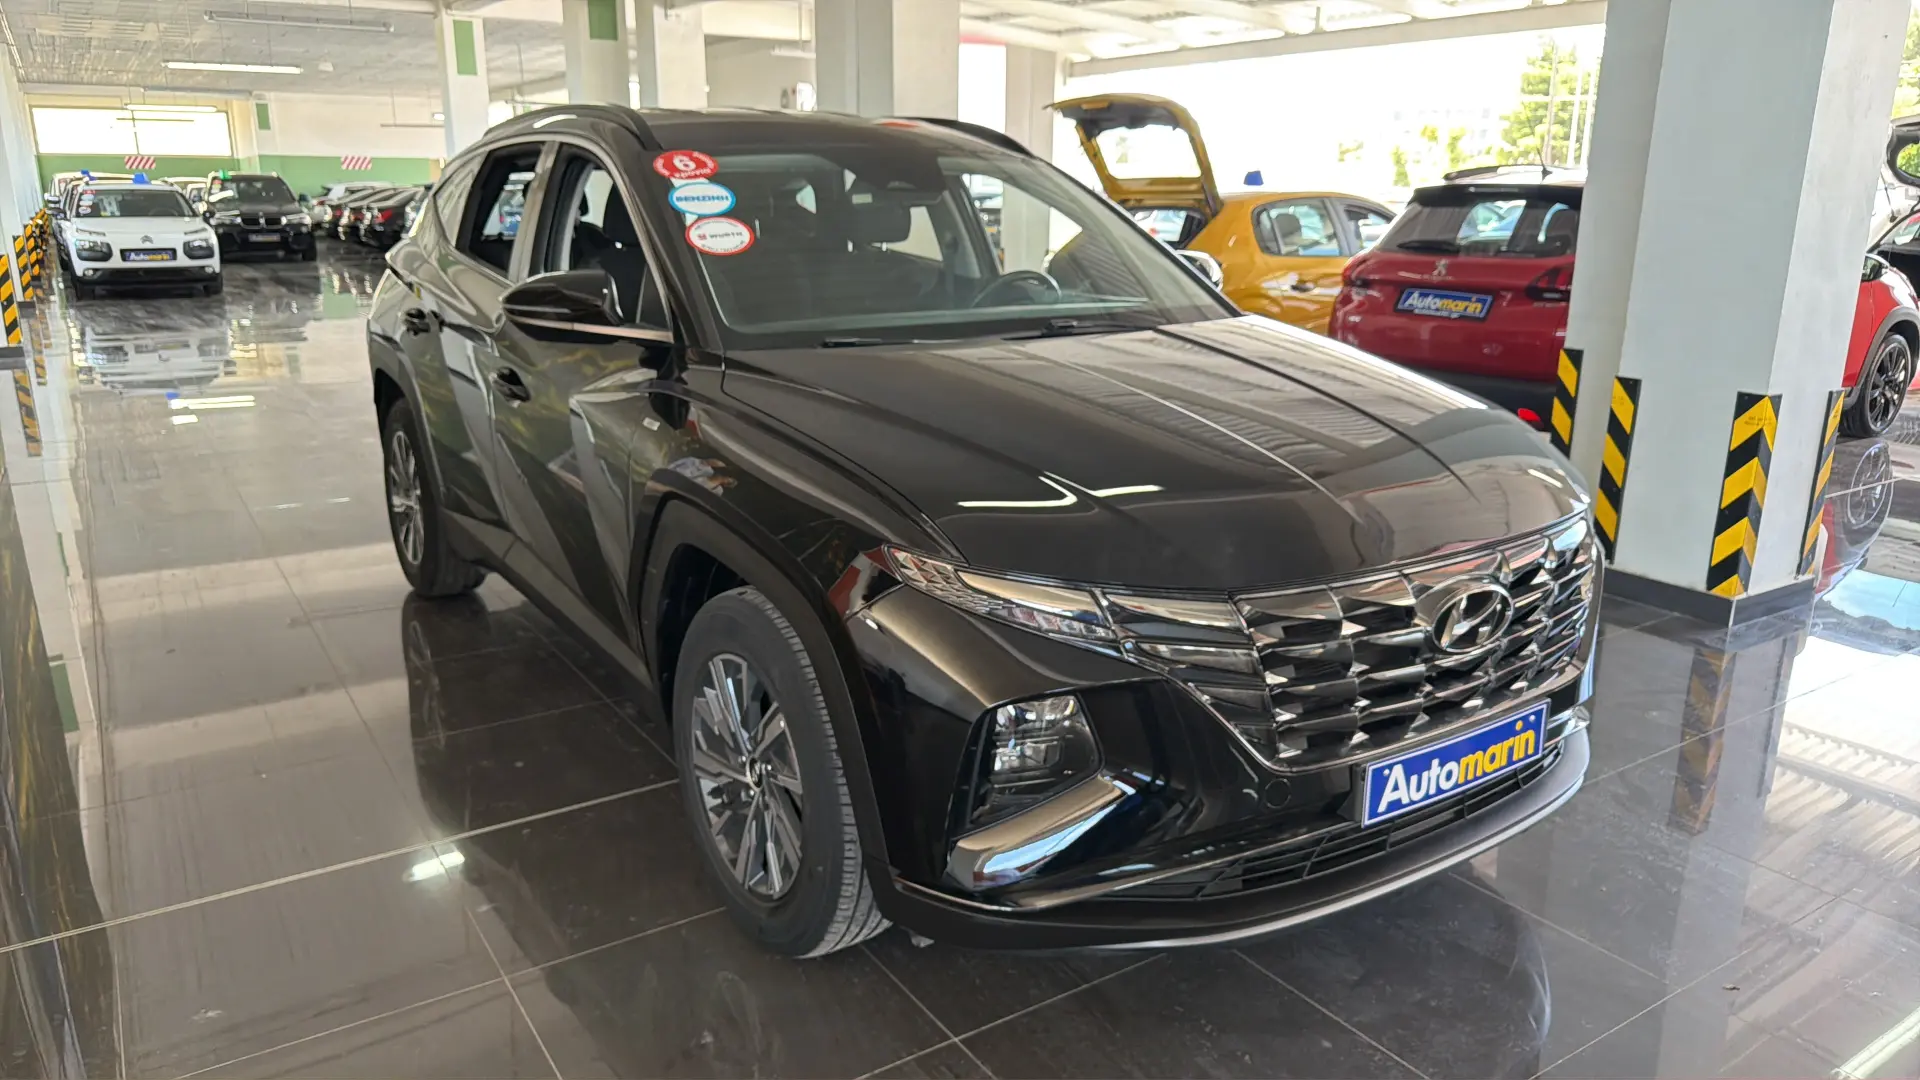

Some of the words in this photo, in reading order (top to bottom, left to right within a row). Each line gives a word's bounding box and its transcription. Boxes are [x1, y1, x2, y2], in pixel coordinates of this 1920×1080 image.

[673, 154, 696, 171] 6
[1404, 291, 1483, 314] Automarin
[1377, 720, 1535, 813] Automarin
